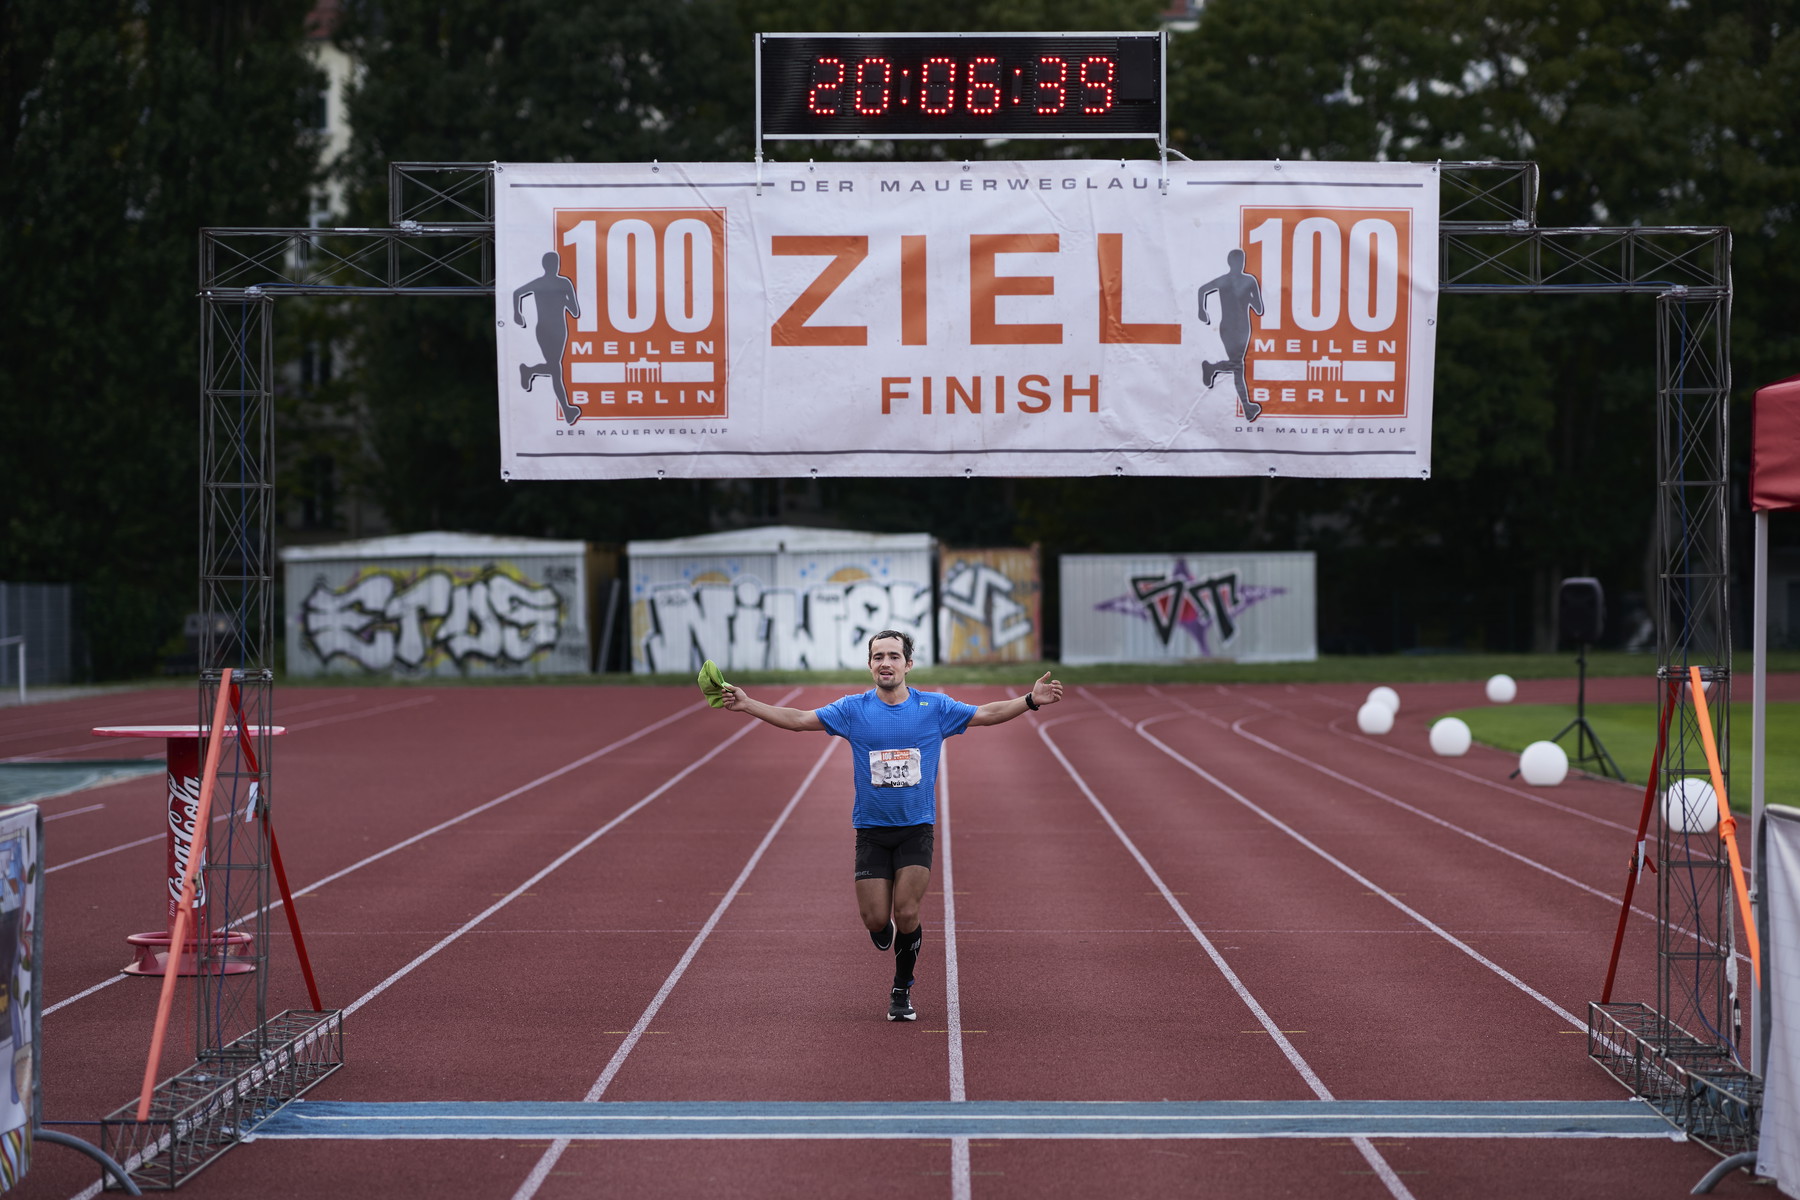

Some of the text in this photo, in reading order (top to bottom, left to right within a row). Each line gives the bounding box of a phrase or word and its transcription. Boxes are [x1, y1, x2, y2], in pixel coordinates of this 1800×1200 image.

[808, 56, 1115, 115] 20:06:39
[790, 177, 1170, 193] DER MAUERWEGLAUF
[563, 218, 714, 333] 100
[1249, 216, 1398, 332] 100
[771, 232, 1182, 346] ZIEL
[571, 340, 714, 355] MEILEN
[1254, 338, 1396, 354] MEILEN
[572, 389, 715, 404] BERLIN
[881, 374, 1099, 414] FINISH
[1253, 388, 1395, 403] BERLIN
[596, 427, 728, 436] MAUERWEGLAUF
[1276, 426, 1406, 434] MAUERWEGLAUF
